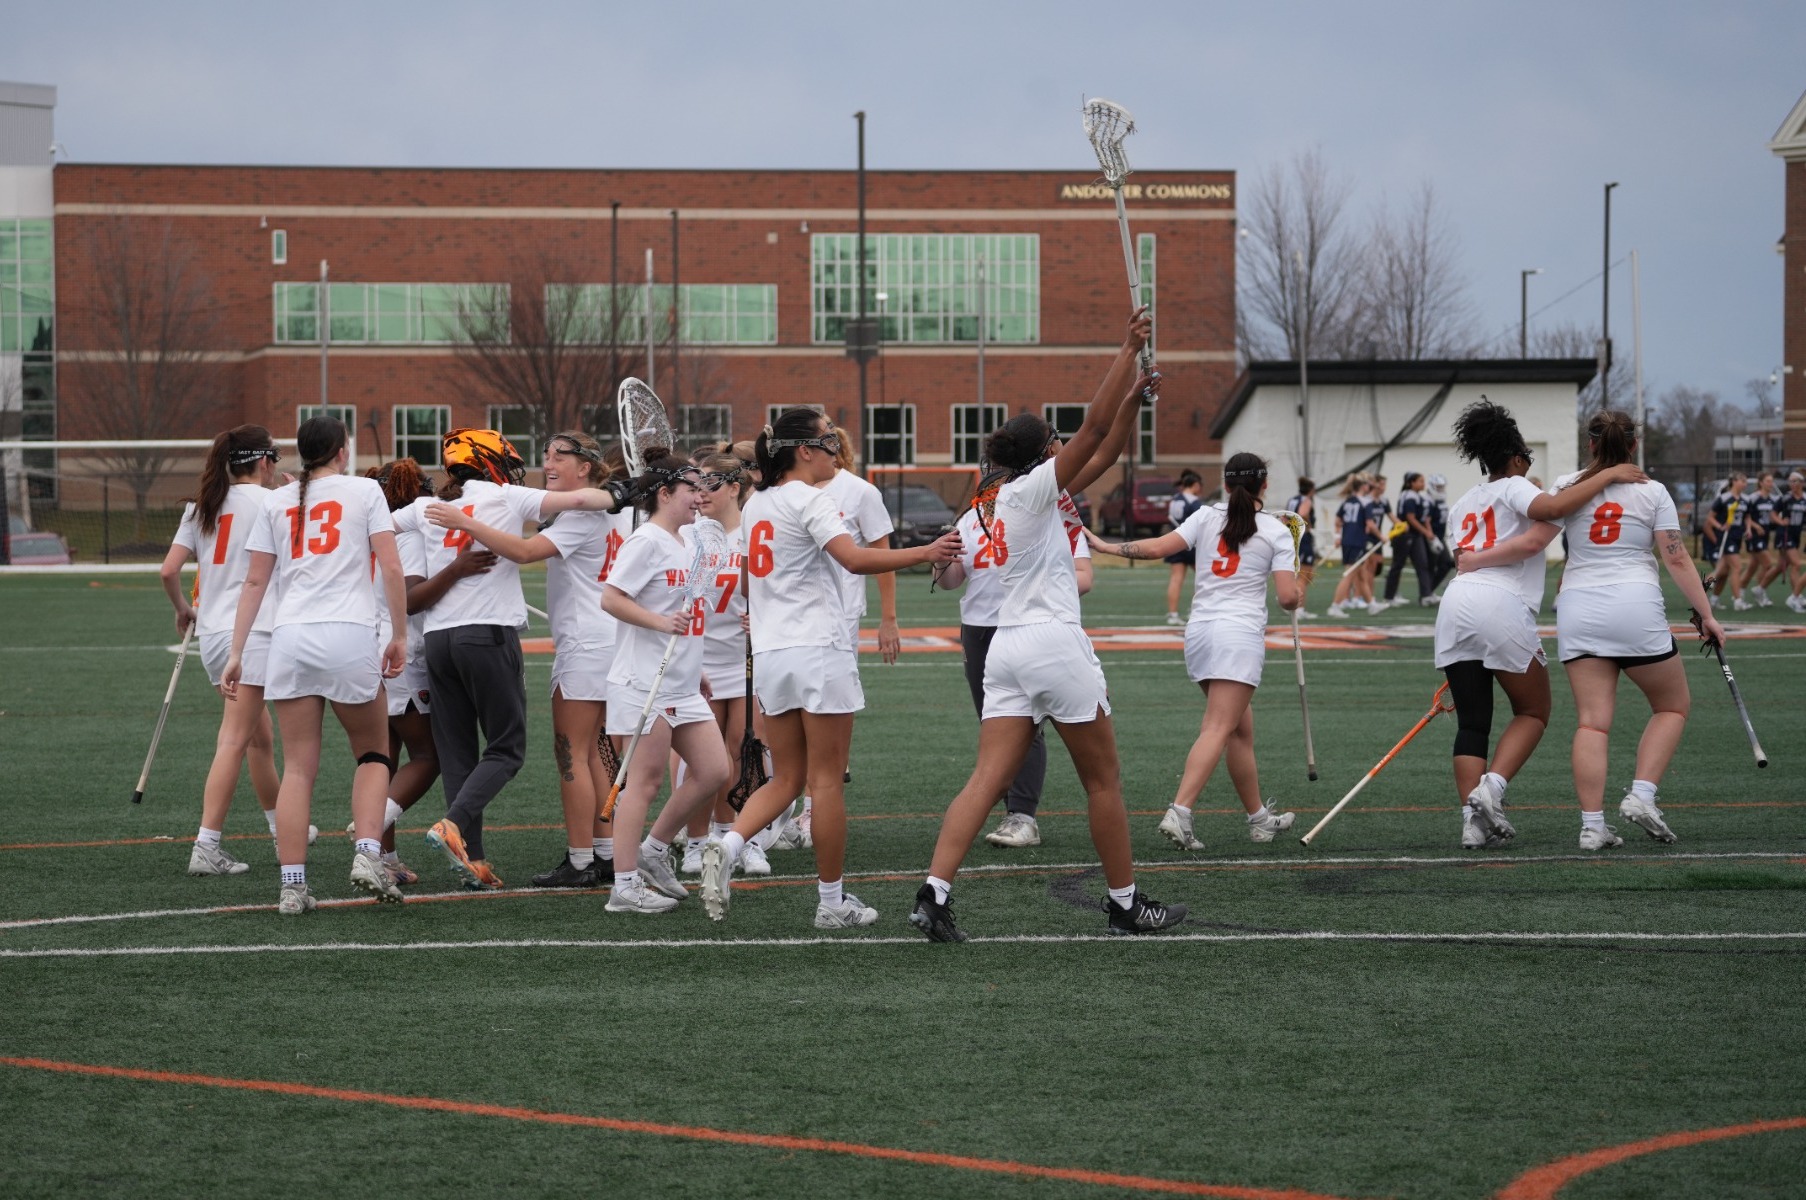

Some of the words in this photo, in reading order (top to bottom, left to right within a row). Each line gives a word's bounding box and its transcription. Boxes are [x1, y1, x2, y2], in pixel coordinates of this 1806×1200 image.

[1145, 184, 1230, 199] COMMONS
[213, 513, 234, 565] 1
[286, 500, 343, 560] 13
[1457, 505, 1497, 552] 21
[1588, 501, 1624, 545] 8
[748, 520, 774, 578] 6
[715, 573, 739, 614] 7
[1722, 664, 1735, 682] STX
